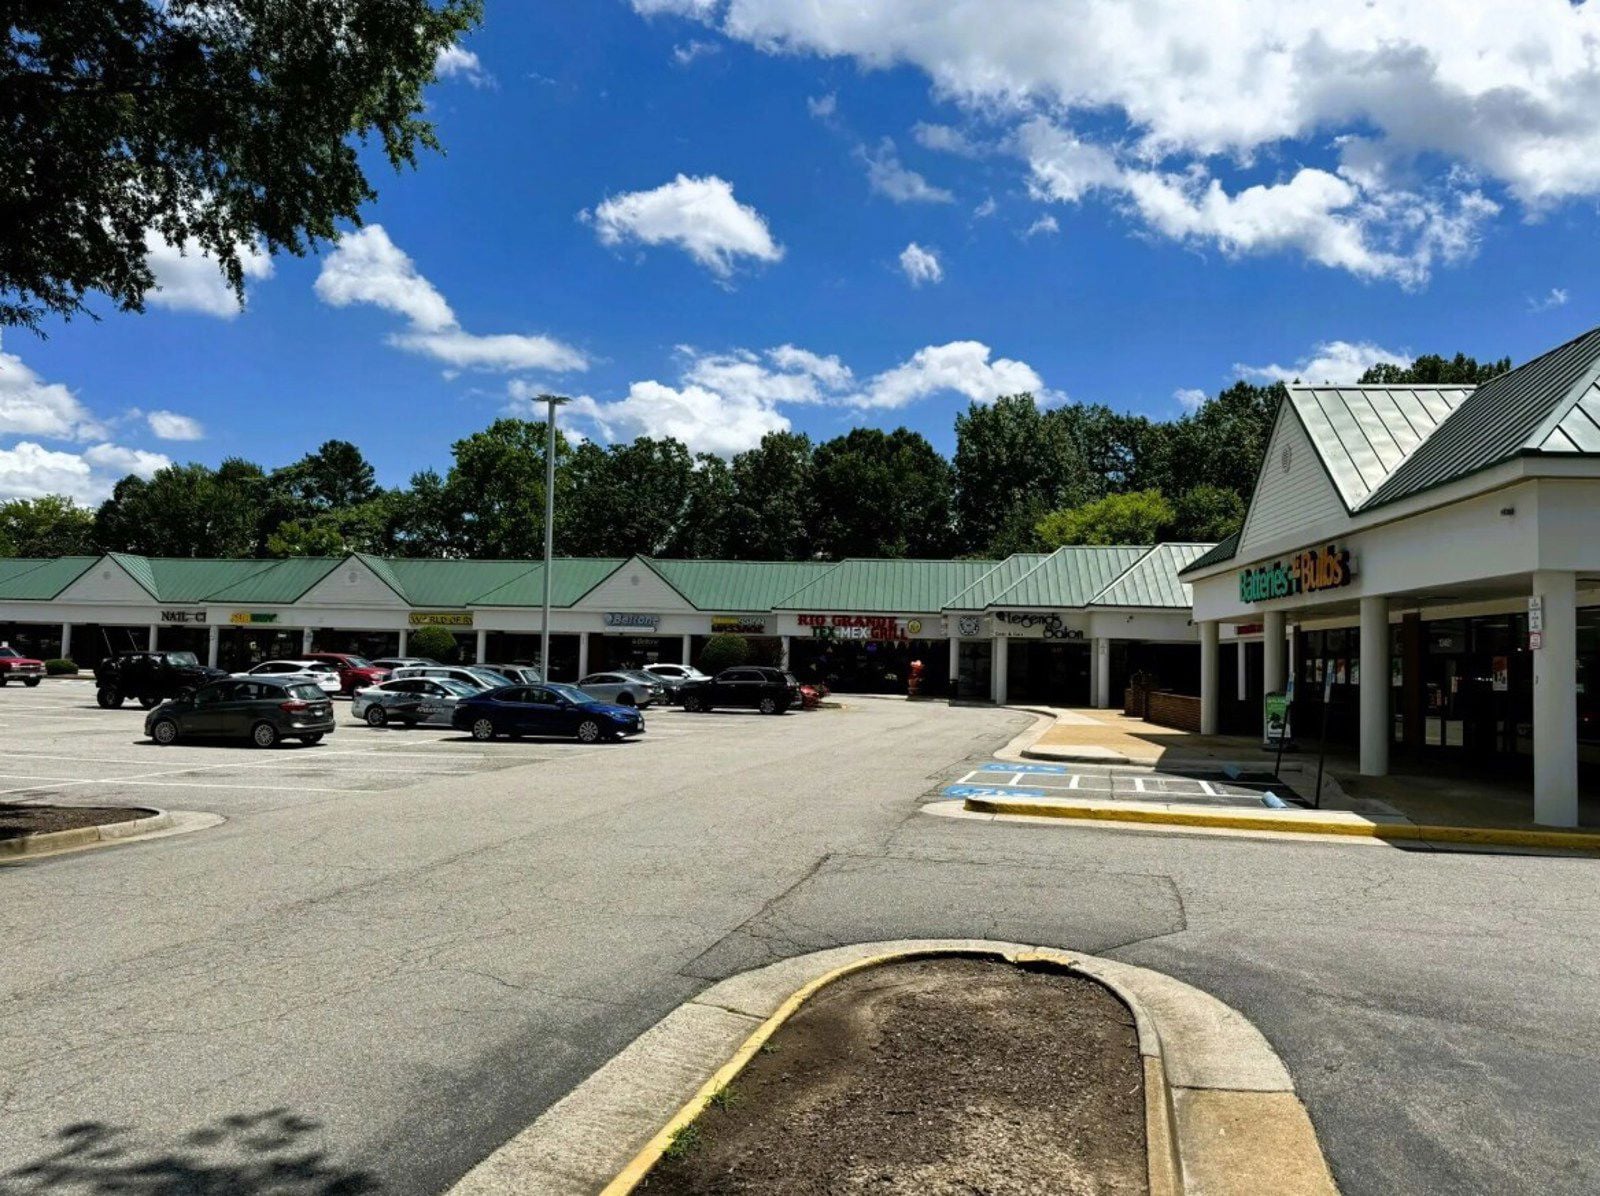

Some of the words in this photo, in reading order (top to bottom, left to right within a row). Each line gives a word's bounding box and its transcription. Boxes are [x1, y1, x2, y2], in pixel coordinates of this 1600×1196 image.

[1239, 565, 1289, 604] Batteries
[1301, 546, 1347, 593] Bulbs
[161, 611, 189, 622] NAIL
[797, 614, 826, 626] RIO
[831, 615, 899, 627] GRANDE
[871, 626, 908, 641] GRILL
[1043, 624, 1083, 640] Salon
